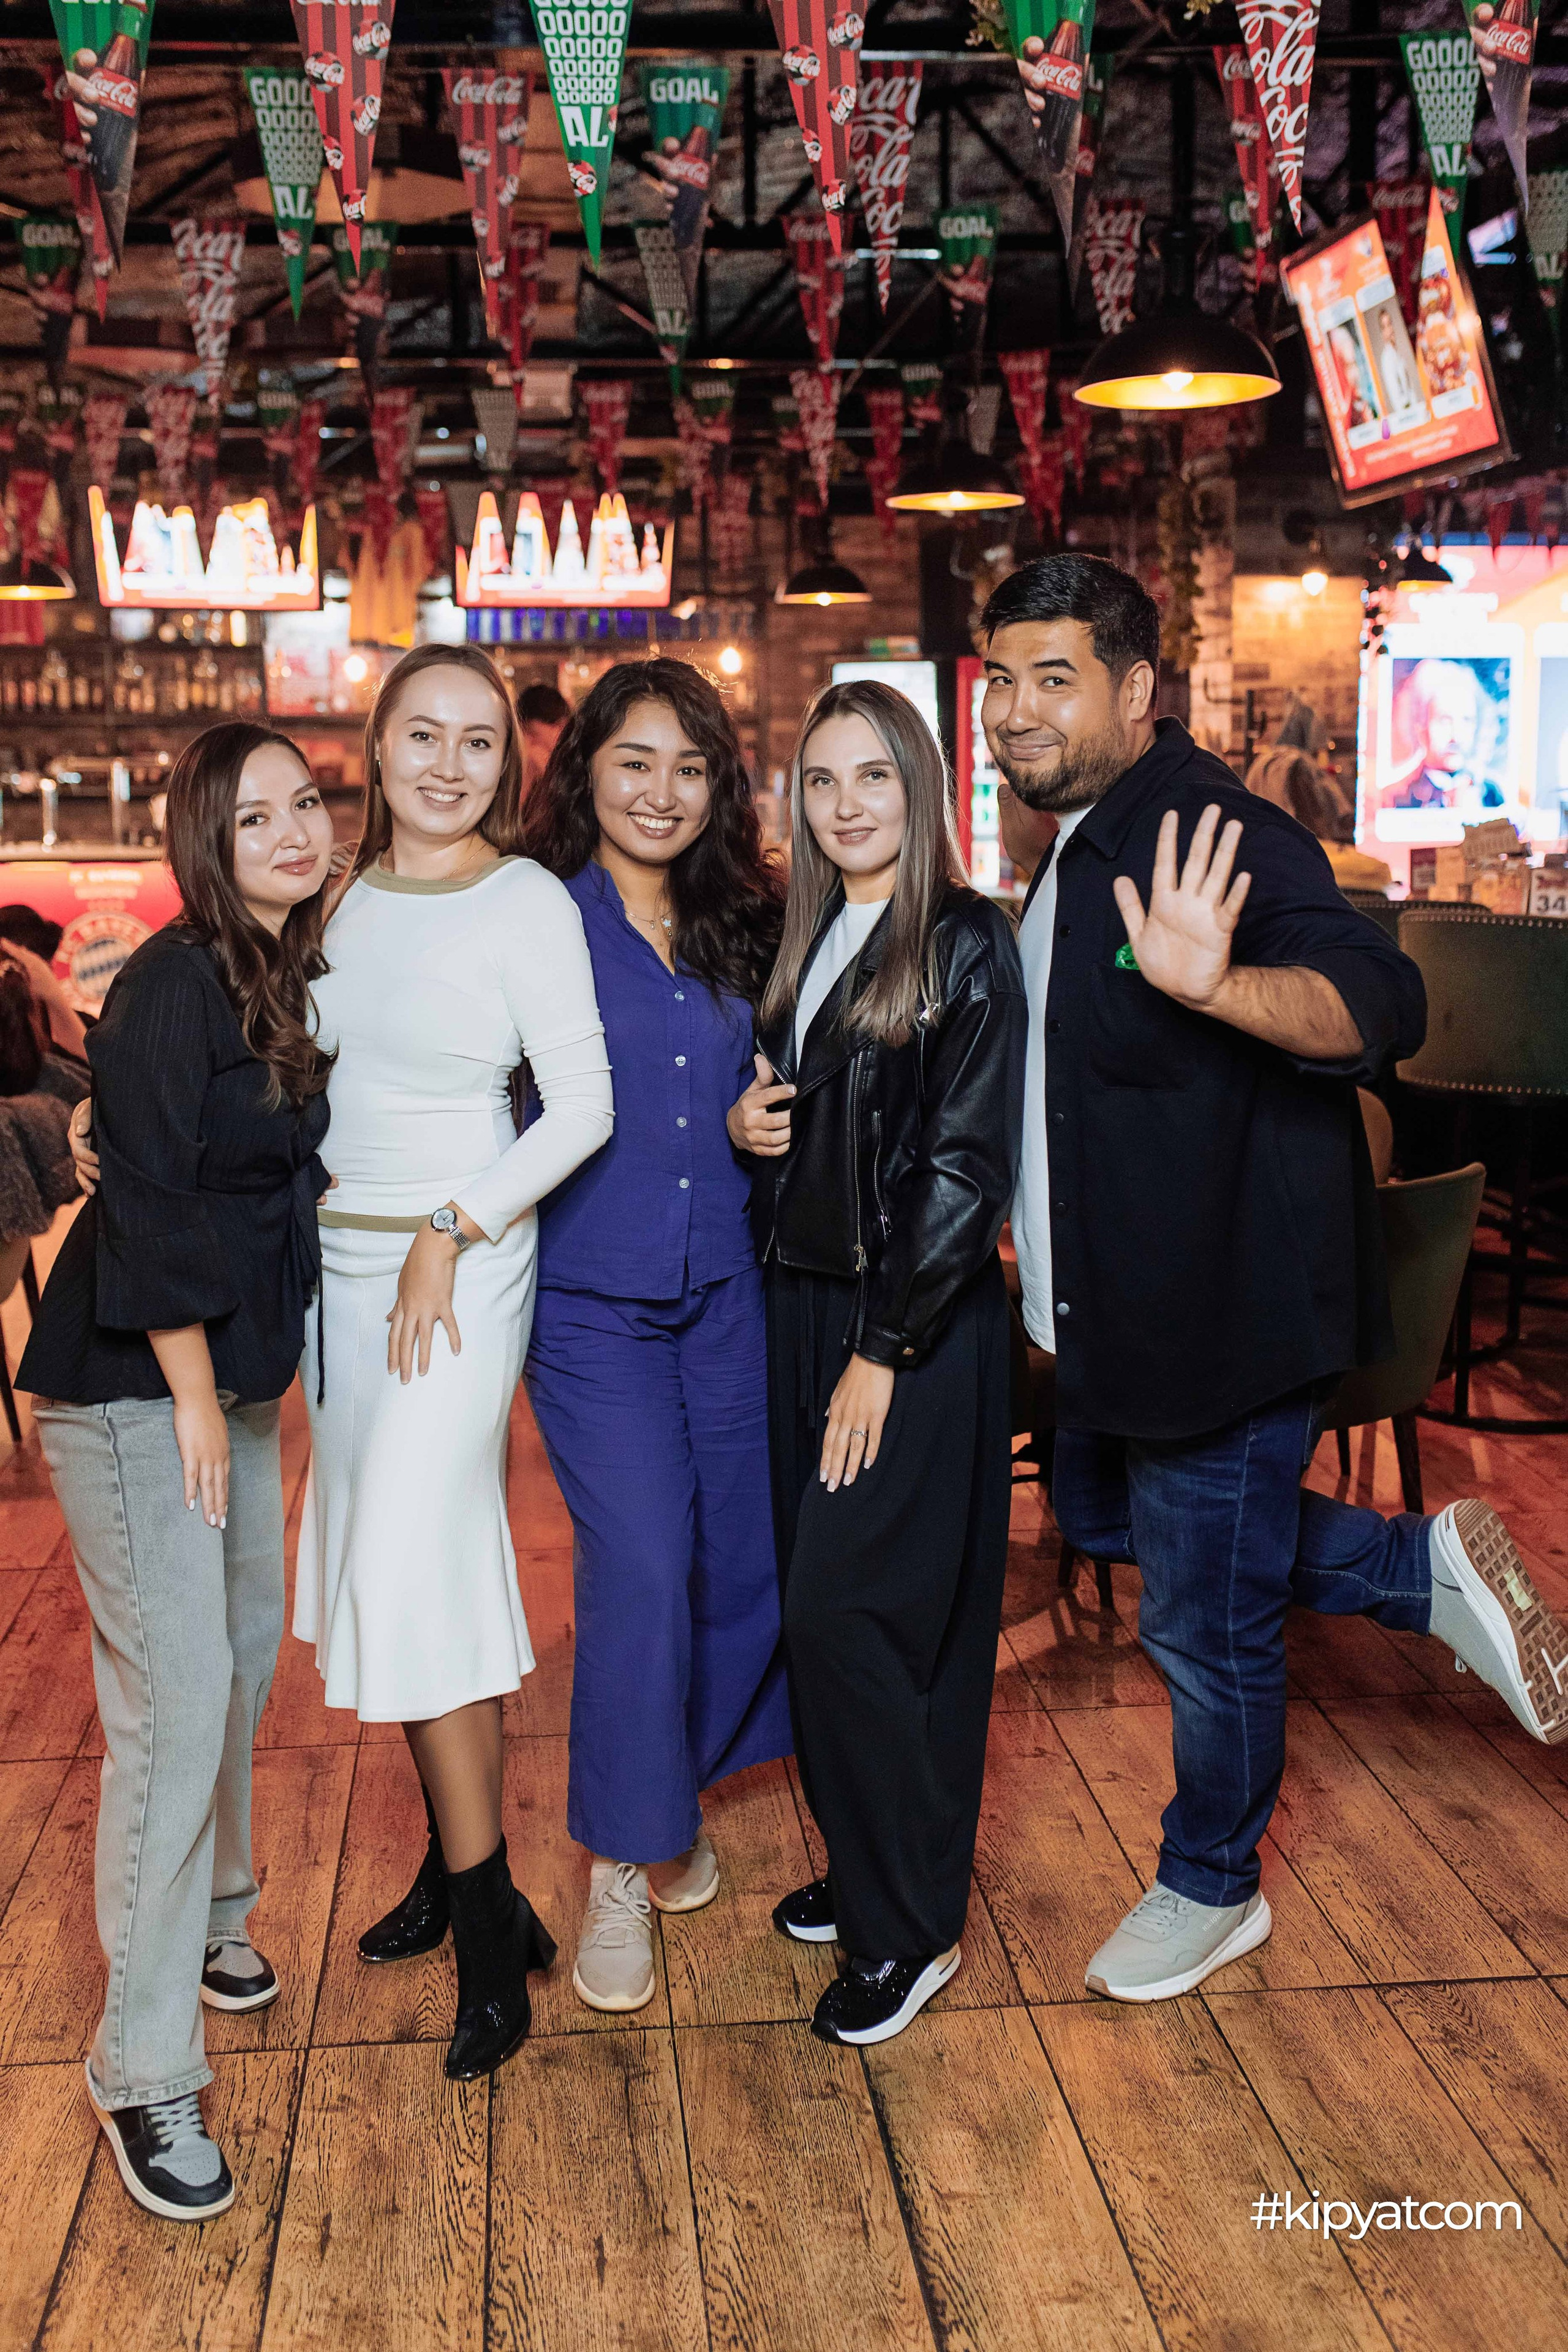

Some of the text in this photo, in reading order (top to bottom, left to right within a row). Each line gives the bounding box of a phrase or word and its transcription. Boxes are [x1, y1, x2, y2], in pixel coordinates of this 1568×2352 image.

[650, 78, 719, 104] GOAL
[559, 106, 609, 147] AL
[1431, 145, 1467, 176] AL
[273, 185, 313, 219] AL
